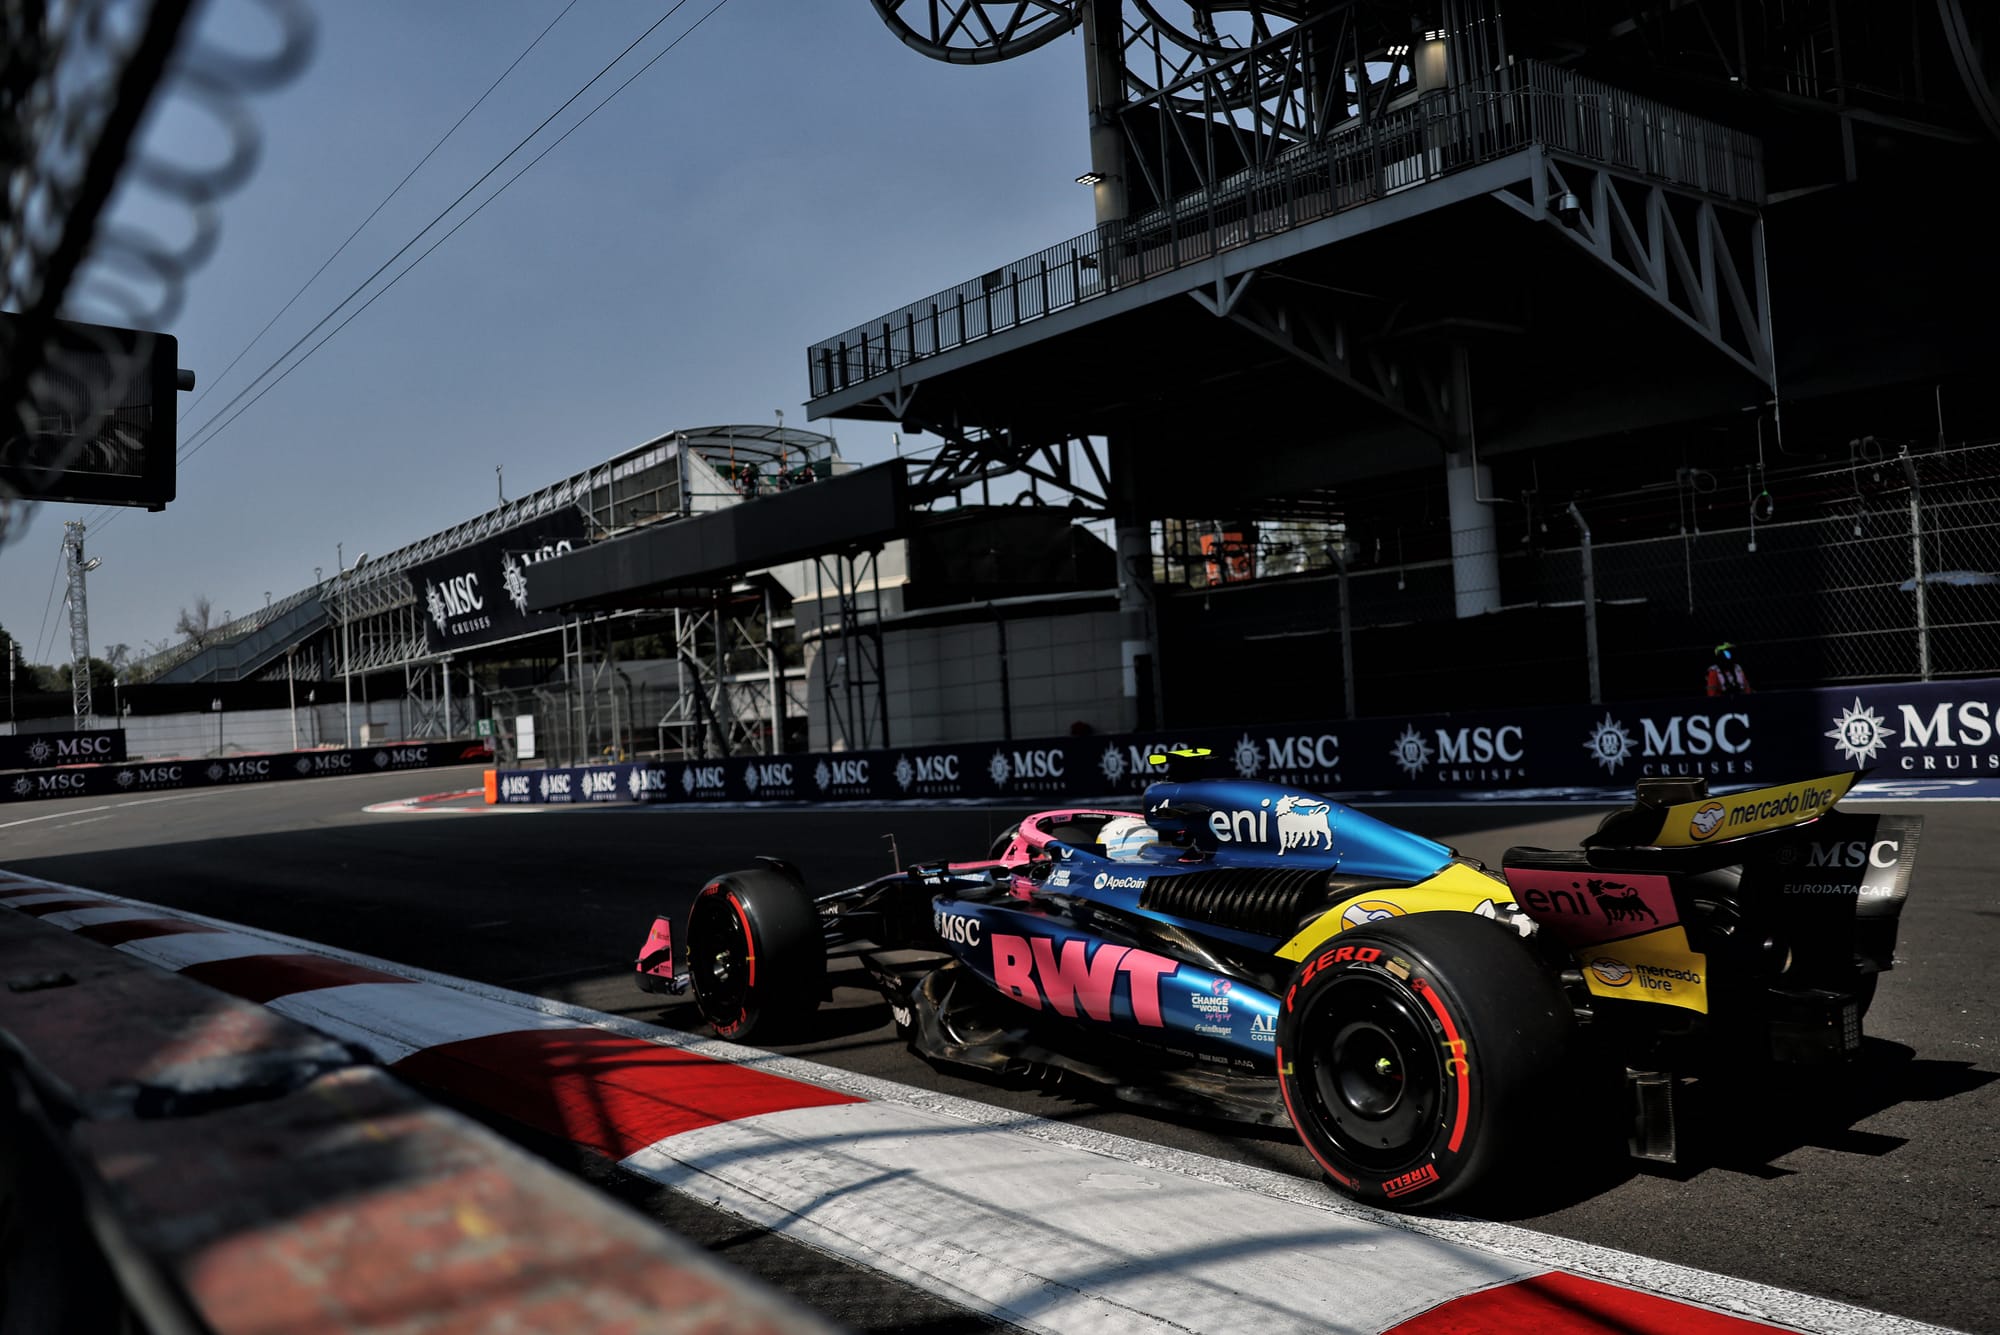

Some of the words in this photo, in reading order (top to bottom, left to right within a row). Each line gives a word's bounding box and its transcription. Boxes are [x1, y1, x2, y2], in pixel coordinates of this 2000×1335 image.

[440, 572, 483, 617] MSC
[452, 616, 491, 635] CRUISES
[1640, 712, 1752, 757] MSC
[1898, 701, 2000, 747] MS
[56, 737, 111, 757] MSC
[1265, 734, 1340, 769] MSC
[1435, 725, 1524, 764] MSC
[315, 754, 351, 770] MSC
[392, 748, 428, 764] MSC
[1012, 749, 1065, 779] MSC
[139, 767, 182, 784] MSC
[228, 760, 270, 776] MSC
[695, 766, 725, 789] MSC
[760, 763, 794, 787] MSC
[831, 759, 870, 785] MSC
[915, 755, 960, 782] MSC
[1642, 761, 1753, 776] CRUISES
[38, 774, 85, 790] MSC
[510, 776, 530, 795] MSC
[550, 774, 571, 794] MSC
[593, 771, 617, 792] MSC
[641, 769, 667, 790] MSC
[1728, 792, 1798, 826] mercado
[1800, 788, 1832, 811] libre
[1209, 798, 1271, 843] eni
[1806, 840, 1899, 868] MSC
[1106, 876, 1147, 889] ApeCoin
[1783, 884, 1893, 897] EURODATACAR
[1524, 882, 1591, 915] eni
[940, 912, 981, 947] MSC
[1301, 946, 1383, 987] ZERO
[1636, 964, 1701, 984] mercado
[991, 933, 1179, 1028] BWT
[1638, 975, 1672, 992] libre
[1191, 996, 1229, 1006] CHANGE
[1200, 1005, 1229, 1013] WORLD
[1381, 1163, 1440, 1199] PIRELLI
